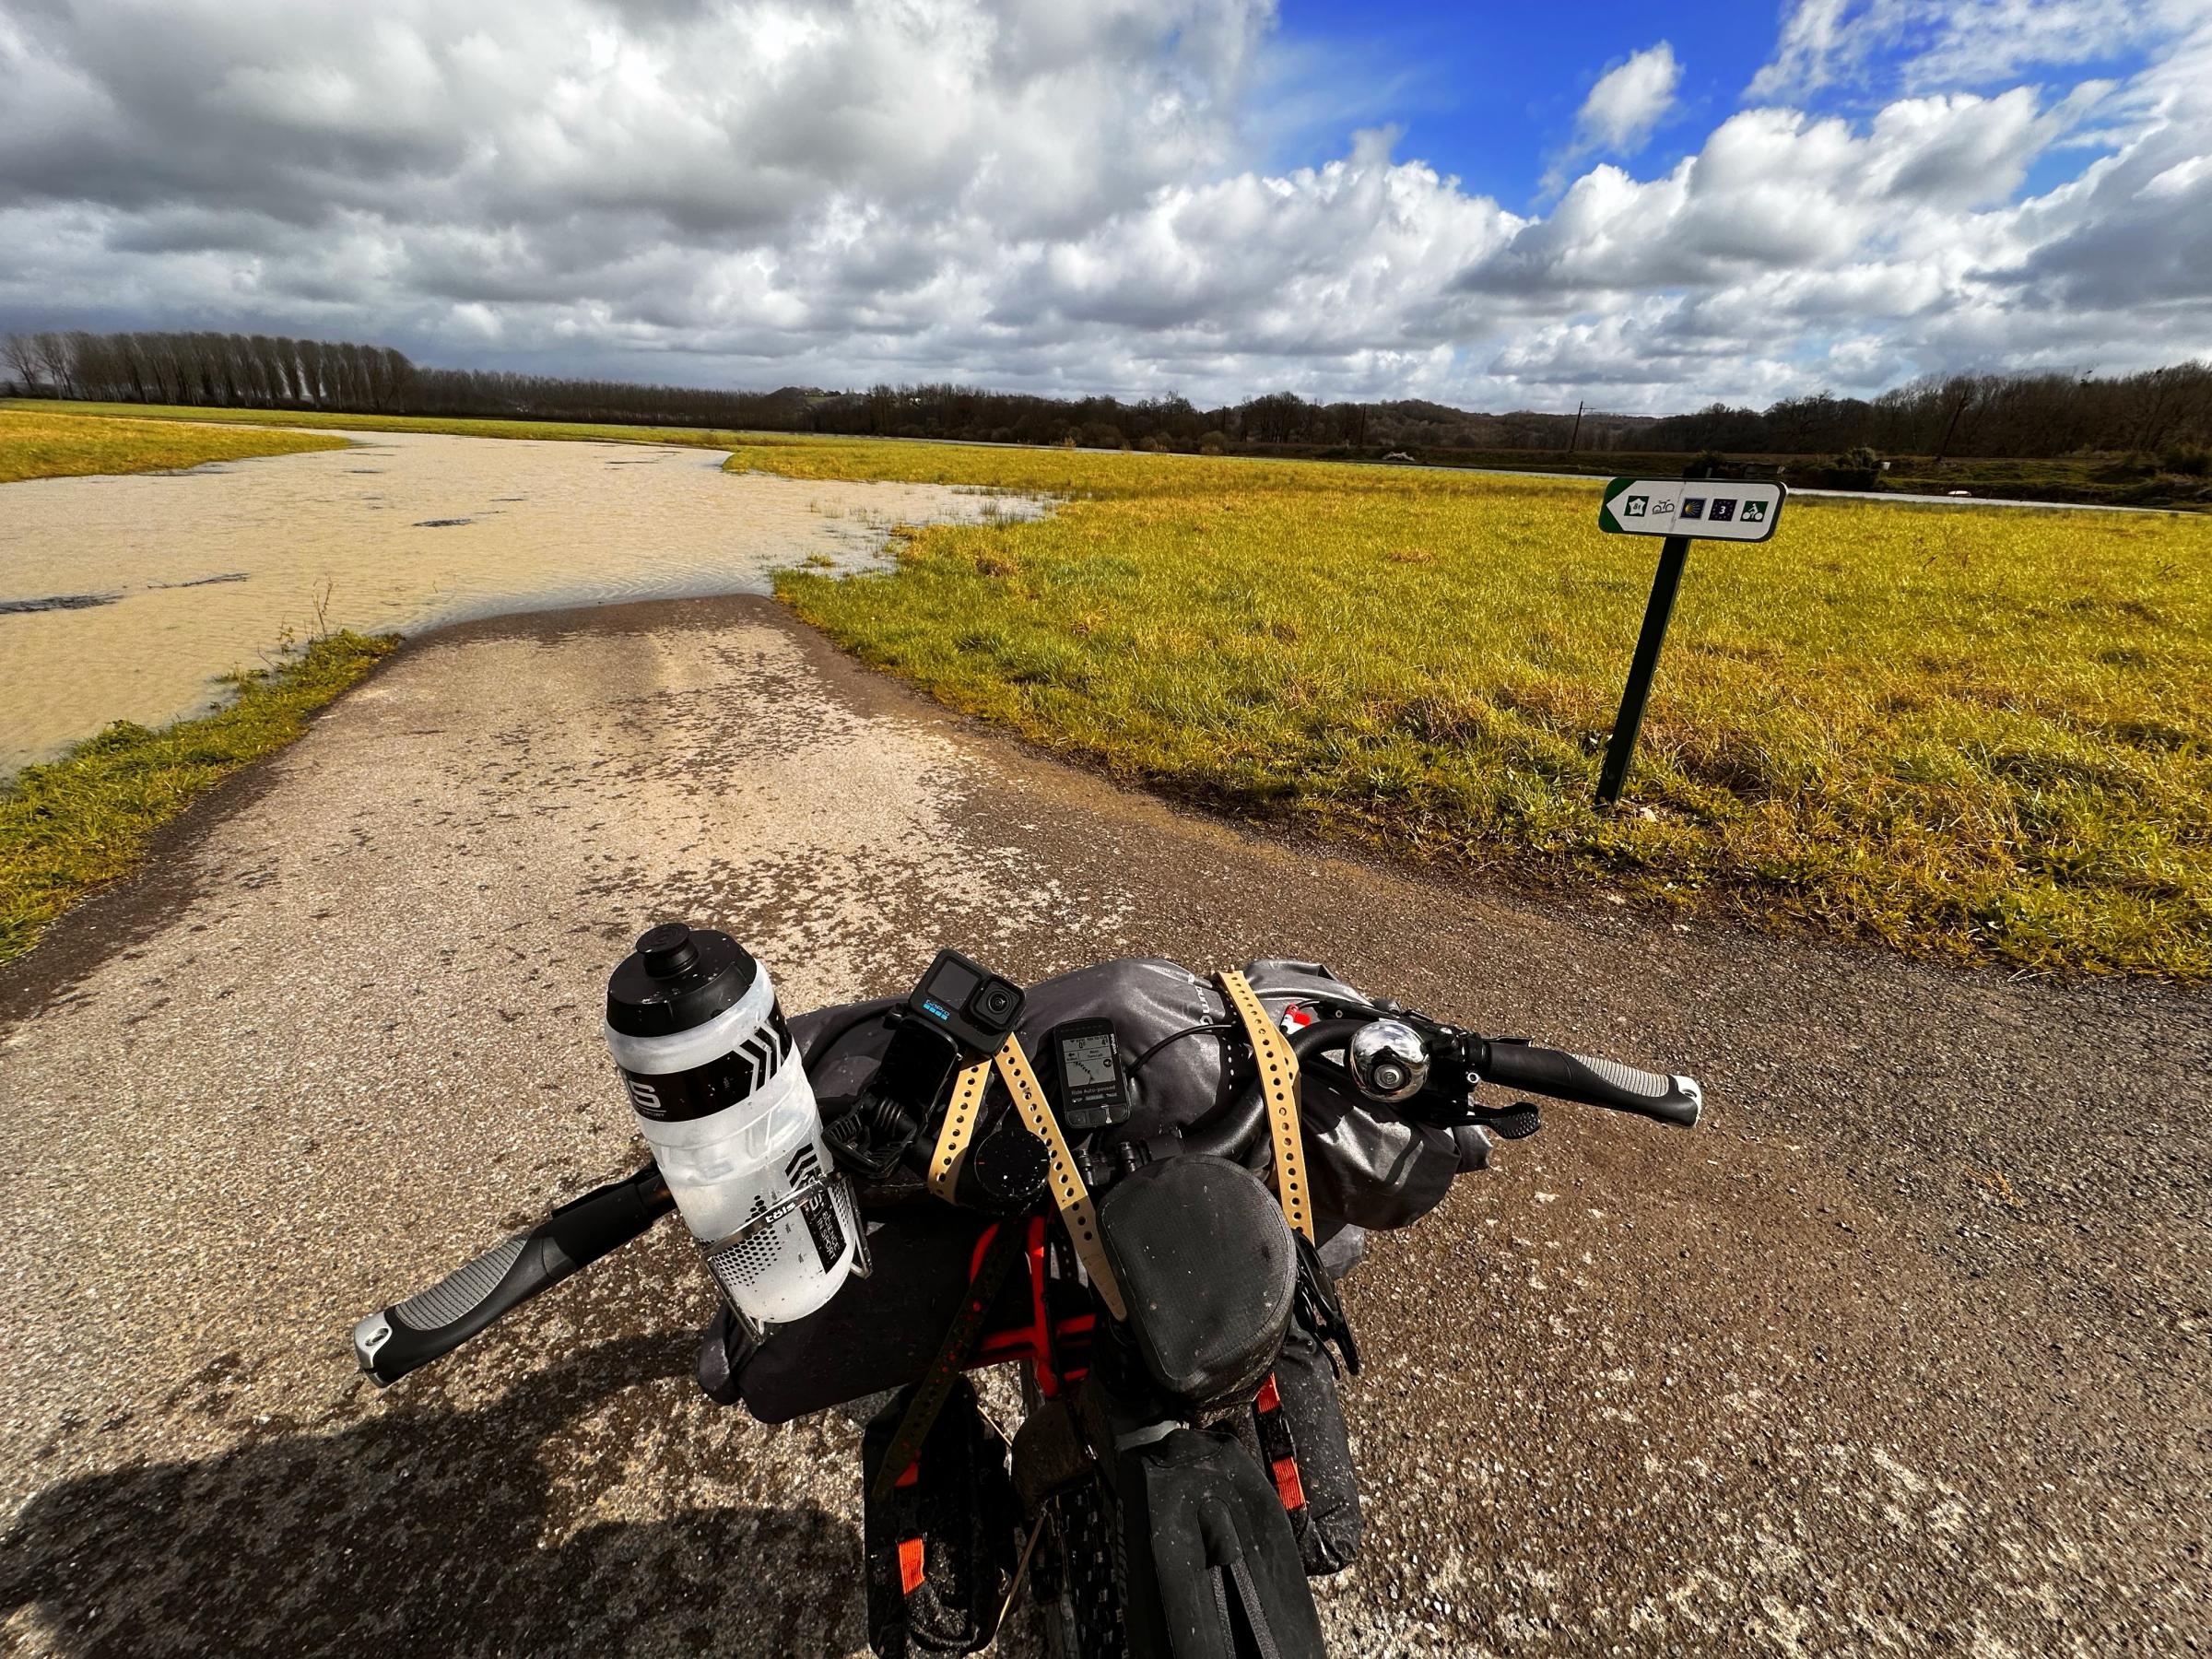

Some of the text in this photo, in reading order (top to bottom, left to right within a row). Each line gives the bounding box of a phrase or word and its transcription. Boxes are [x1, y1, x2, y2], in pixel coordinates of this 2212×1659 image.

[1719, 506, 1725, 514] 3
[817, 1218, 837, 1260] IN SPORT
[823, 1210, 841, 1251] SCIENCE
